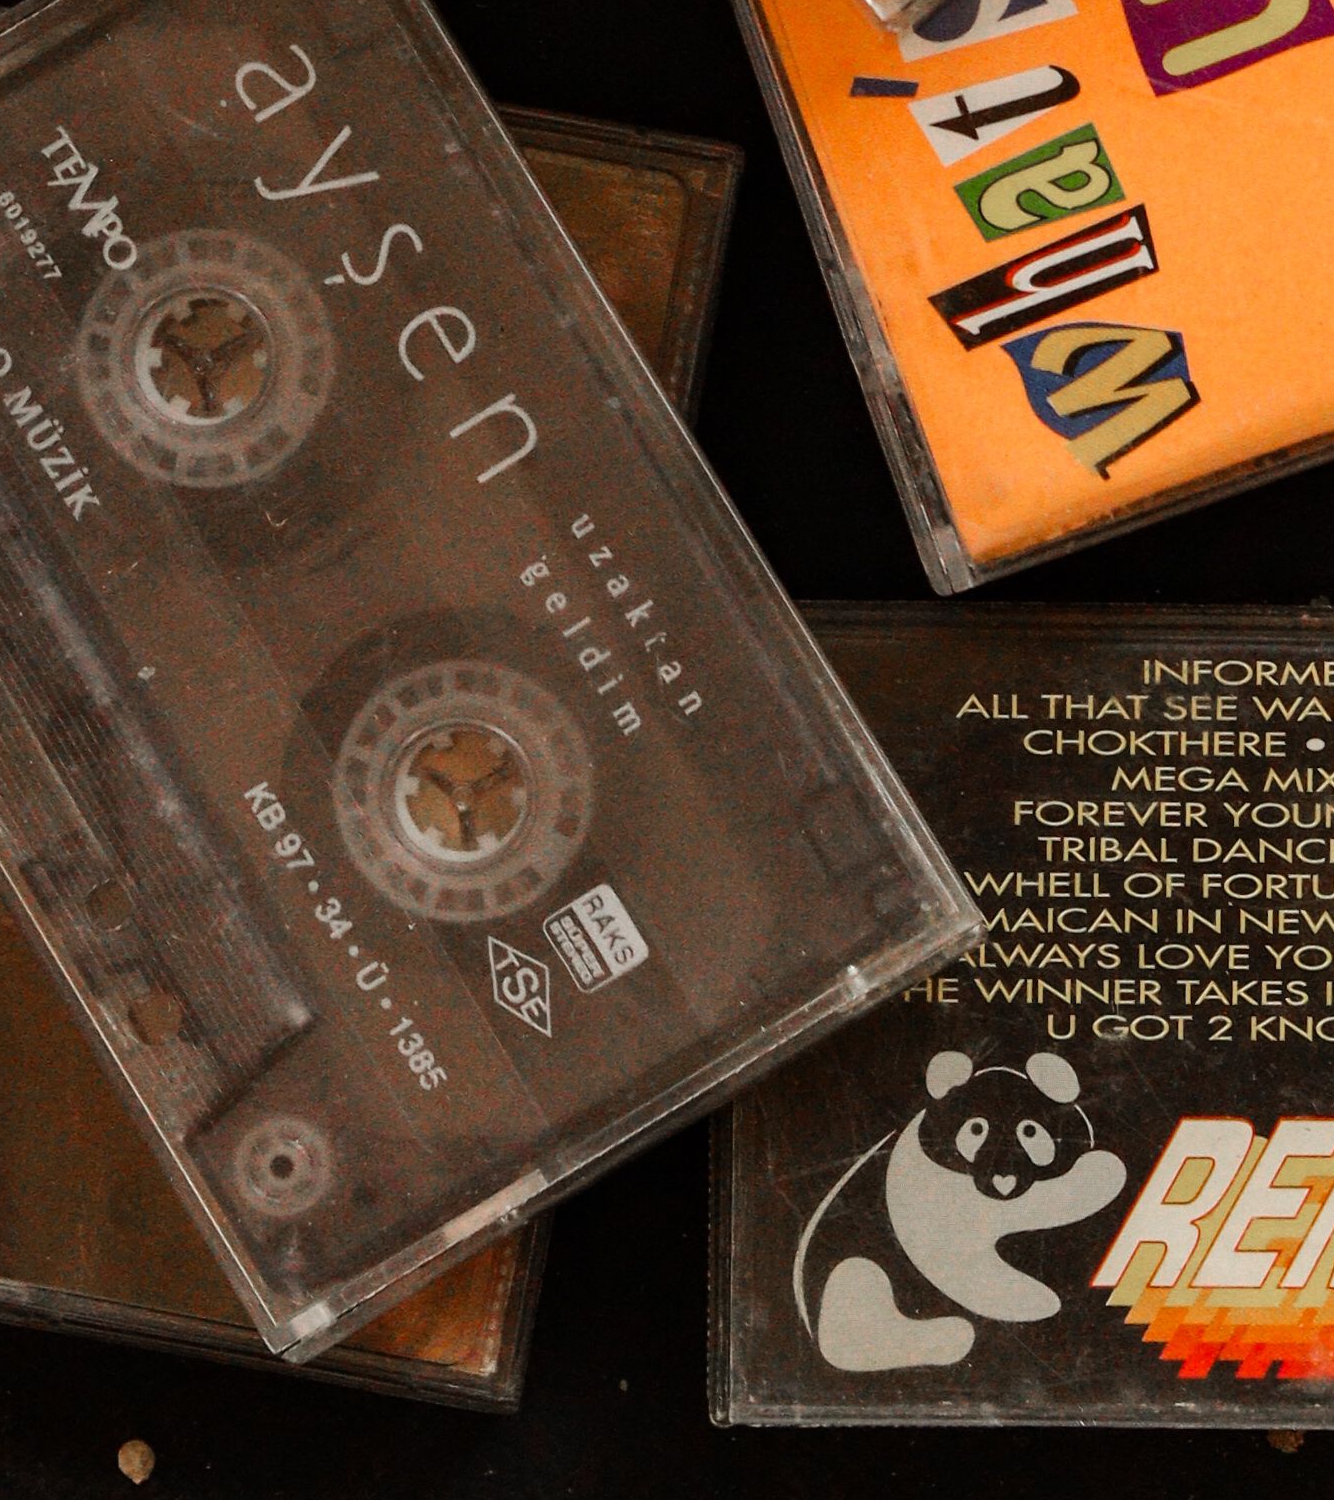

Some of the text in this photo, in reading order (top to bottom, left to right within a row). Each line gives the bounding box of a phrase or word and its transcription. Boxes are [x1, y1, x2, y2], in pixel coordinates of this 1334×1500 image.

[236, 44, 540, 485] ayşen
[1, 380, 110, 524] MÜZİK
[956, 696, 1031, 721] ALL
[1040, 696, 1145, 721] THAT
[1111, 766, 1248, 794] MEGA
[241, 779, 289, 834] KB
[1012, 802, 1211, 829] FOREVER
[1038, 837, 1180, 865] TRIBAL
[580, 891, 636, 968] RAKS
[1141, 944, 1261, 971] LOVE
[486, 943, 555, 1028] TSE
